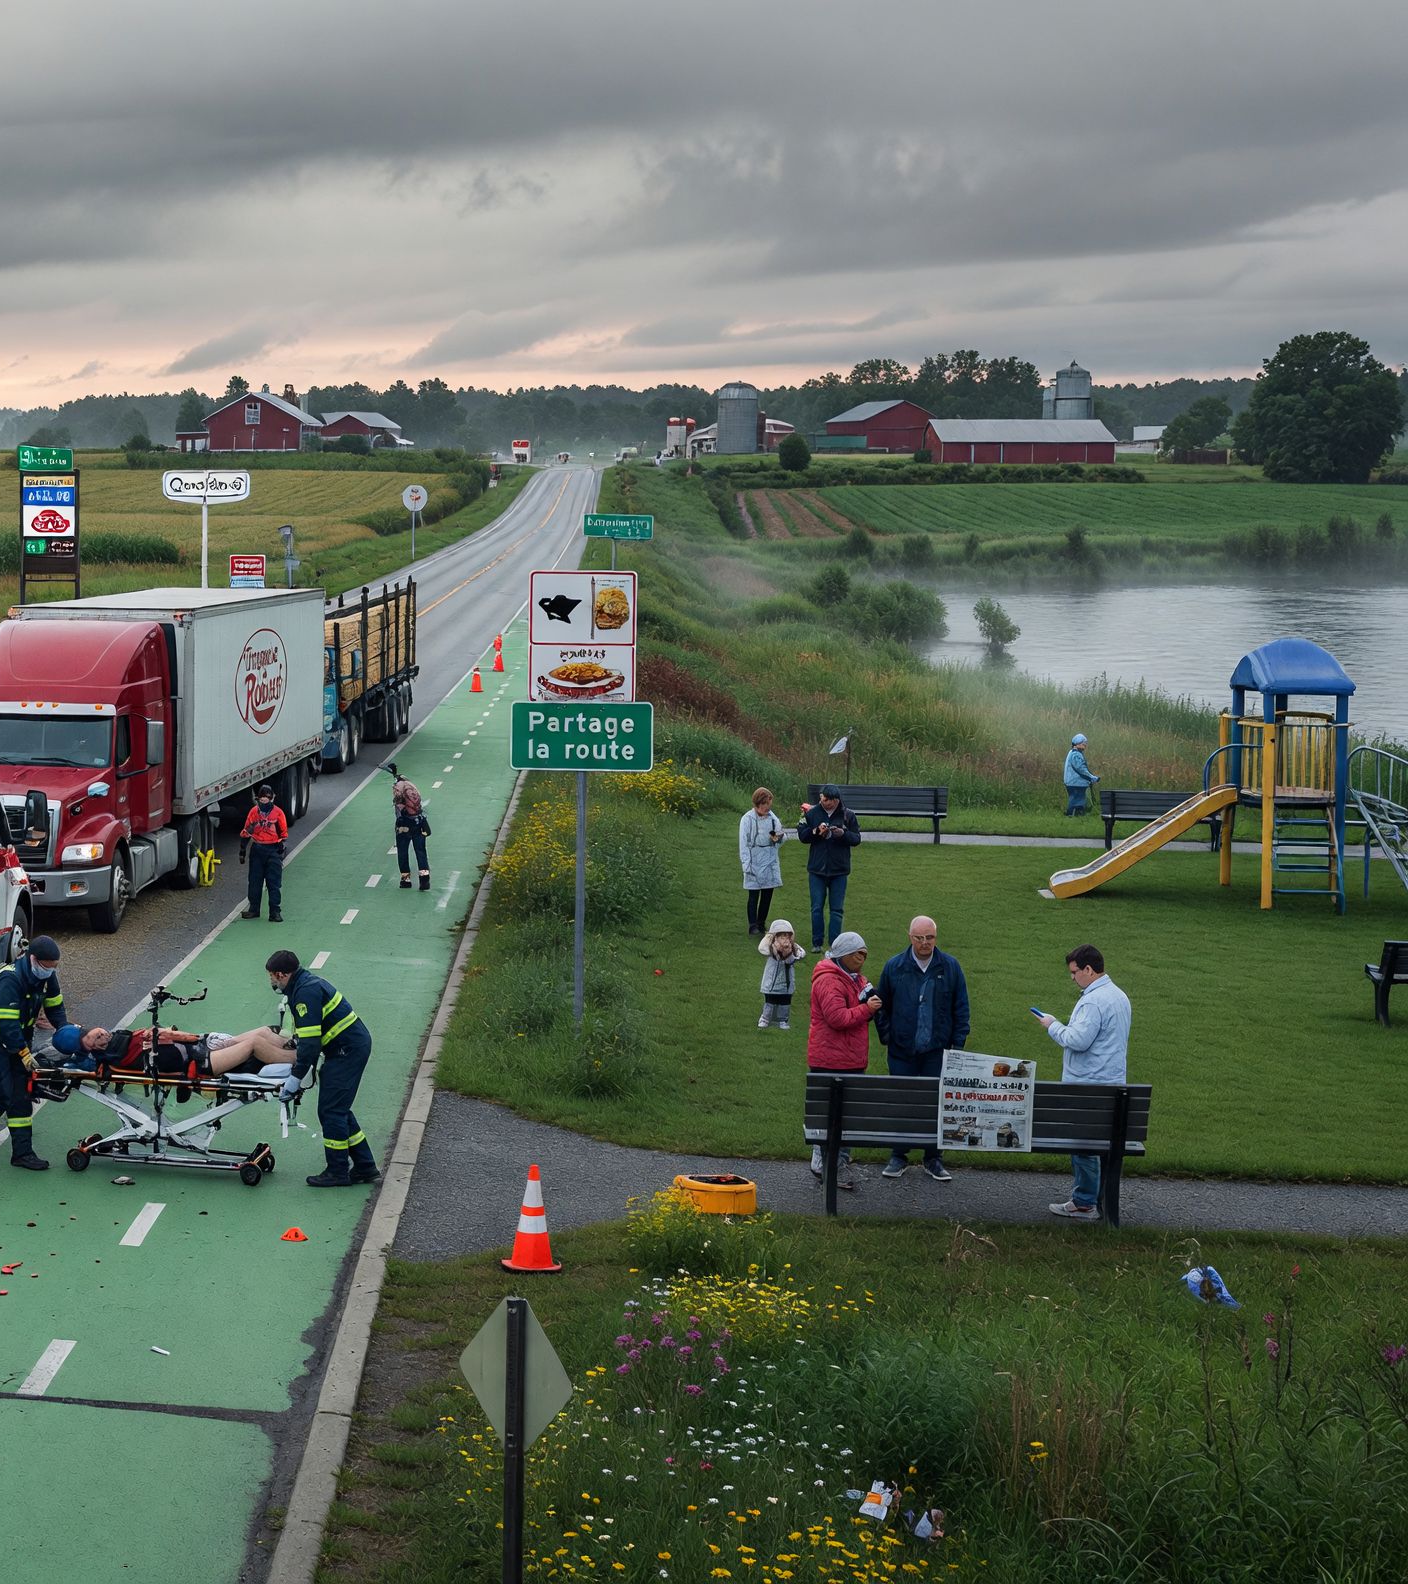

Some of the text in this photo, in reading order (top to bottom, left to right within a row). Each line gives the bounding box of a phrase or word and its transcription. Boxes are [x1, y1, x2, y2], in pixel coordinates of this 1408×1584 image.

[528, 711, 635, 739] Partage
[528, 739, 635, 760] la route
